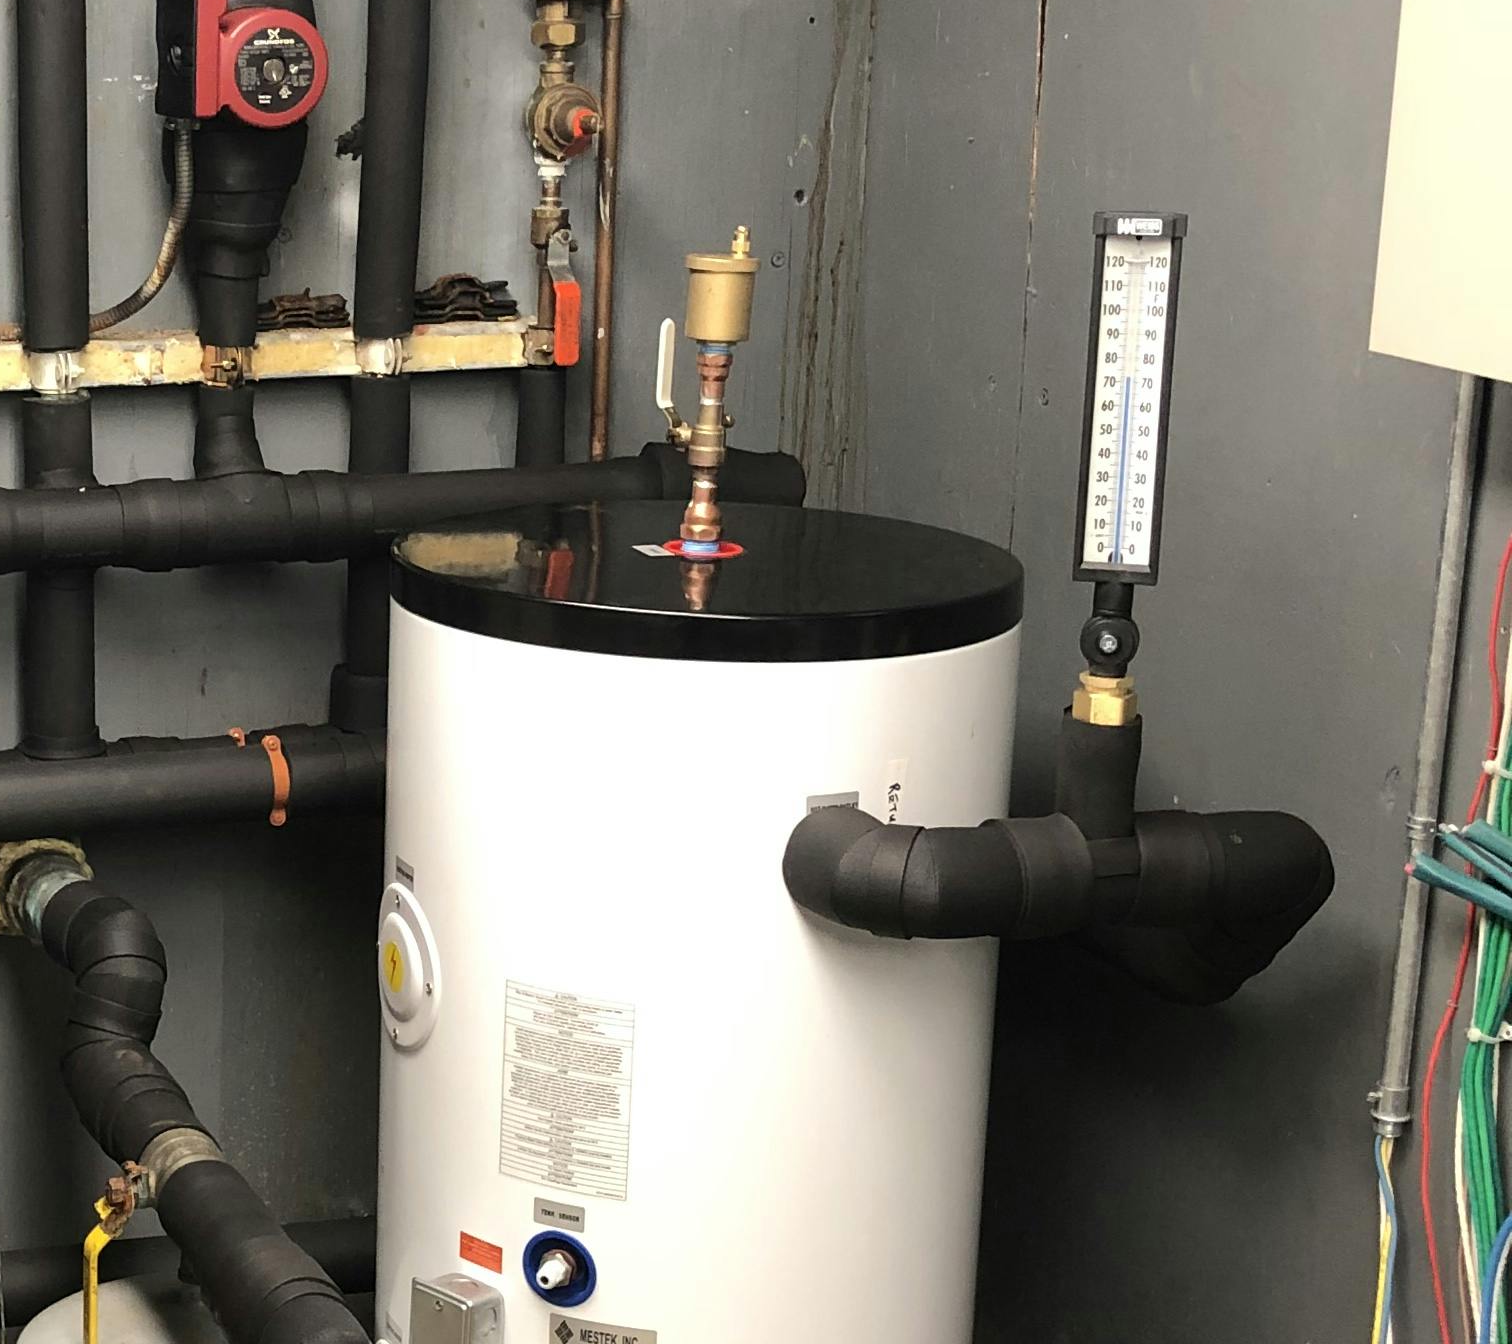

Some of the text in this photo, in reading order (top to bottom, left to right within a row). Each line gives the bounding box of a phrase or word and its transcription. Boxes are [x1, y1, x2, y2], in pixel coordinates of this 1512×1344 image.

[1106, 256, 1167, 268] 120 120
[1105, 281, 1165, 292] 110 110
[1103, 304, 1163, 316] 100 100
[1107, 329, 1156, 340] 90 90
[1105, 353, 1154, 364] 80 80
[1104, 377, 1152, 388] 70 70
[1102, 401, 1151, 413] 60 60
[1100, 424, 1149, 437] 50 50
[1098, 448, 1148, 460] 40 40
[1096, 472, 1146, 484] 30 30
[1095, 495, 1144, 508] 20 20
[1094, 519, 1141, 531] 10 10
[1098, 542, 1134, 554] 0 0
